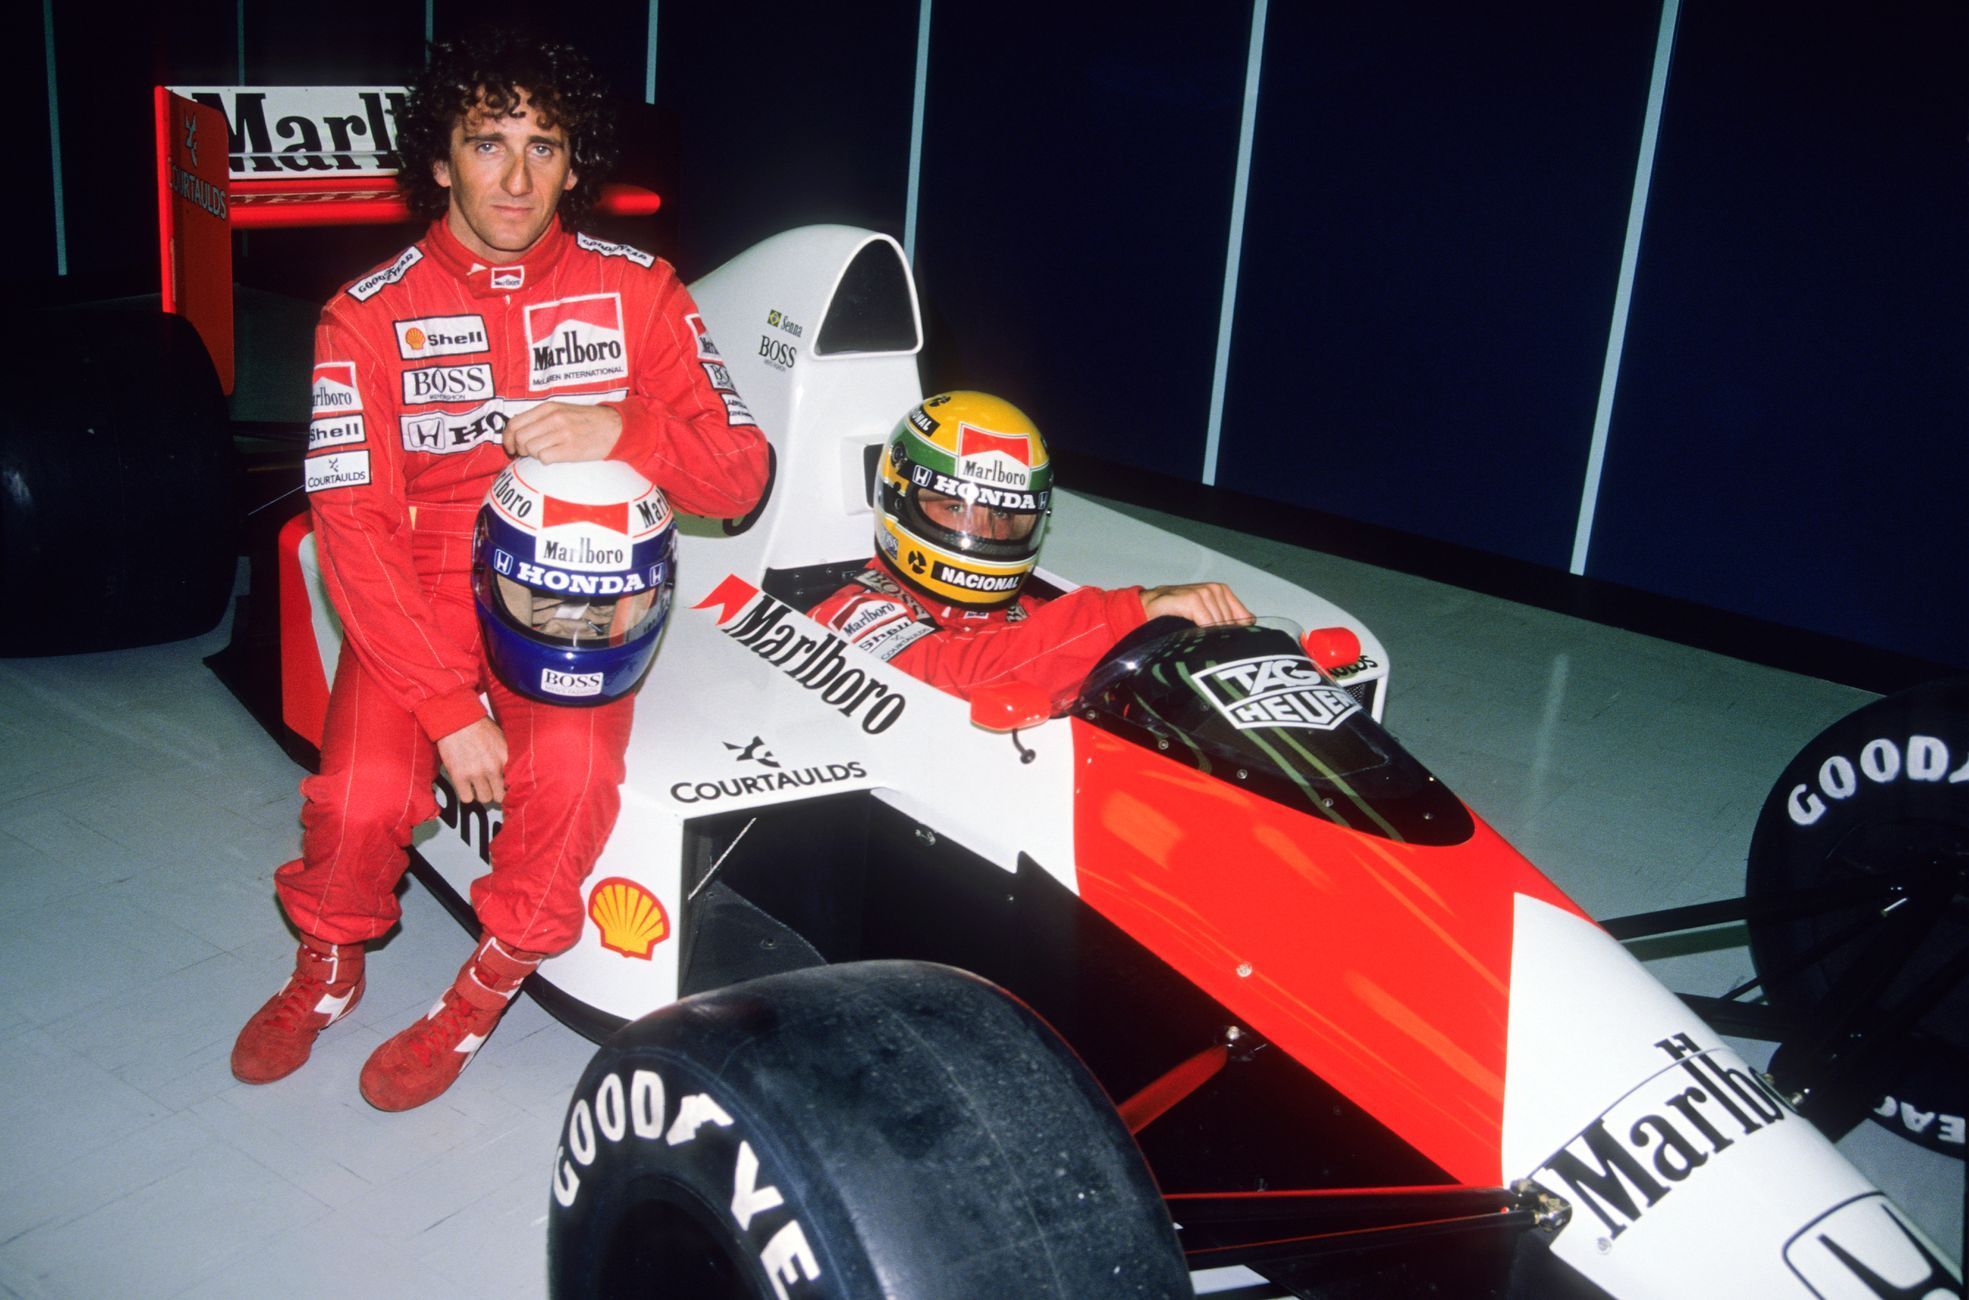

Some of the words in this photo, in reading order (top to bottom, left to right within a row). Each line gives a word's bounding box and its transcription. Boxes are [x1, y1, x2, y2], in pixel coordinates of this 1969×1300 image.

[191, 92, 406, 172] Marl
[427, 331, 483, 347] Shell
[781, 315, 803, 338] Senna
[533, 330, 622, 372] Marlboro
[758, 335, 797, 368] BOSS
[412, 367, 486, 396] BOSS
[564, 366, 624, 380] INTERNATIONAL
[307, 470, 366, 488] COURTAULDS
[962, 459, 1027, 486] Marlboro
[933, 474, 1037, 510] HONDA
[543, 537, 624, 565] Marlboro
[516, 562, 645, 594] HONDA
[941, 566, 1020, 591] NACIONAL
[843, 602, 896, 637] Marlboro
[545, 671, 601, 688] BOSS
[721, 594, 907, 735] Marlboro
[1219, 659, 1321, 695] TAG
[670, 761, 868, 804] COURTAULDS
